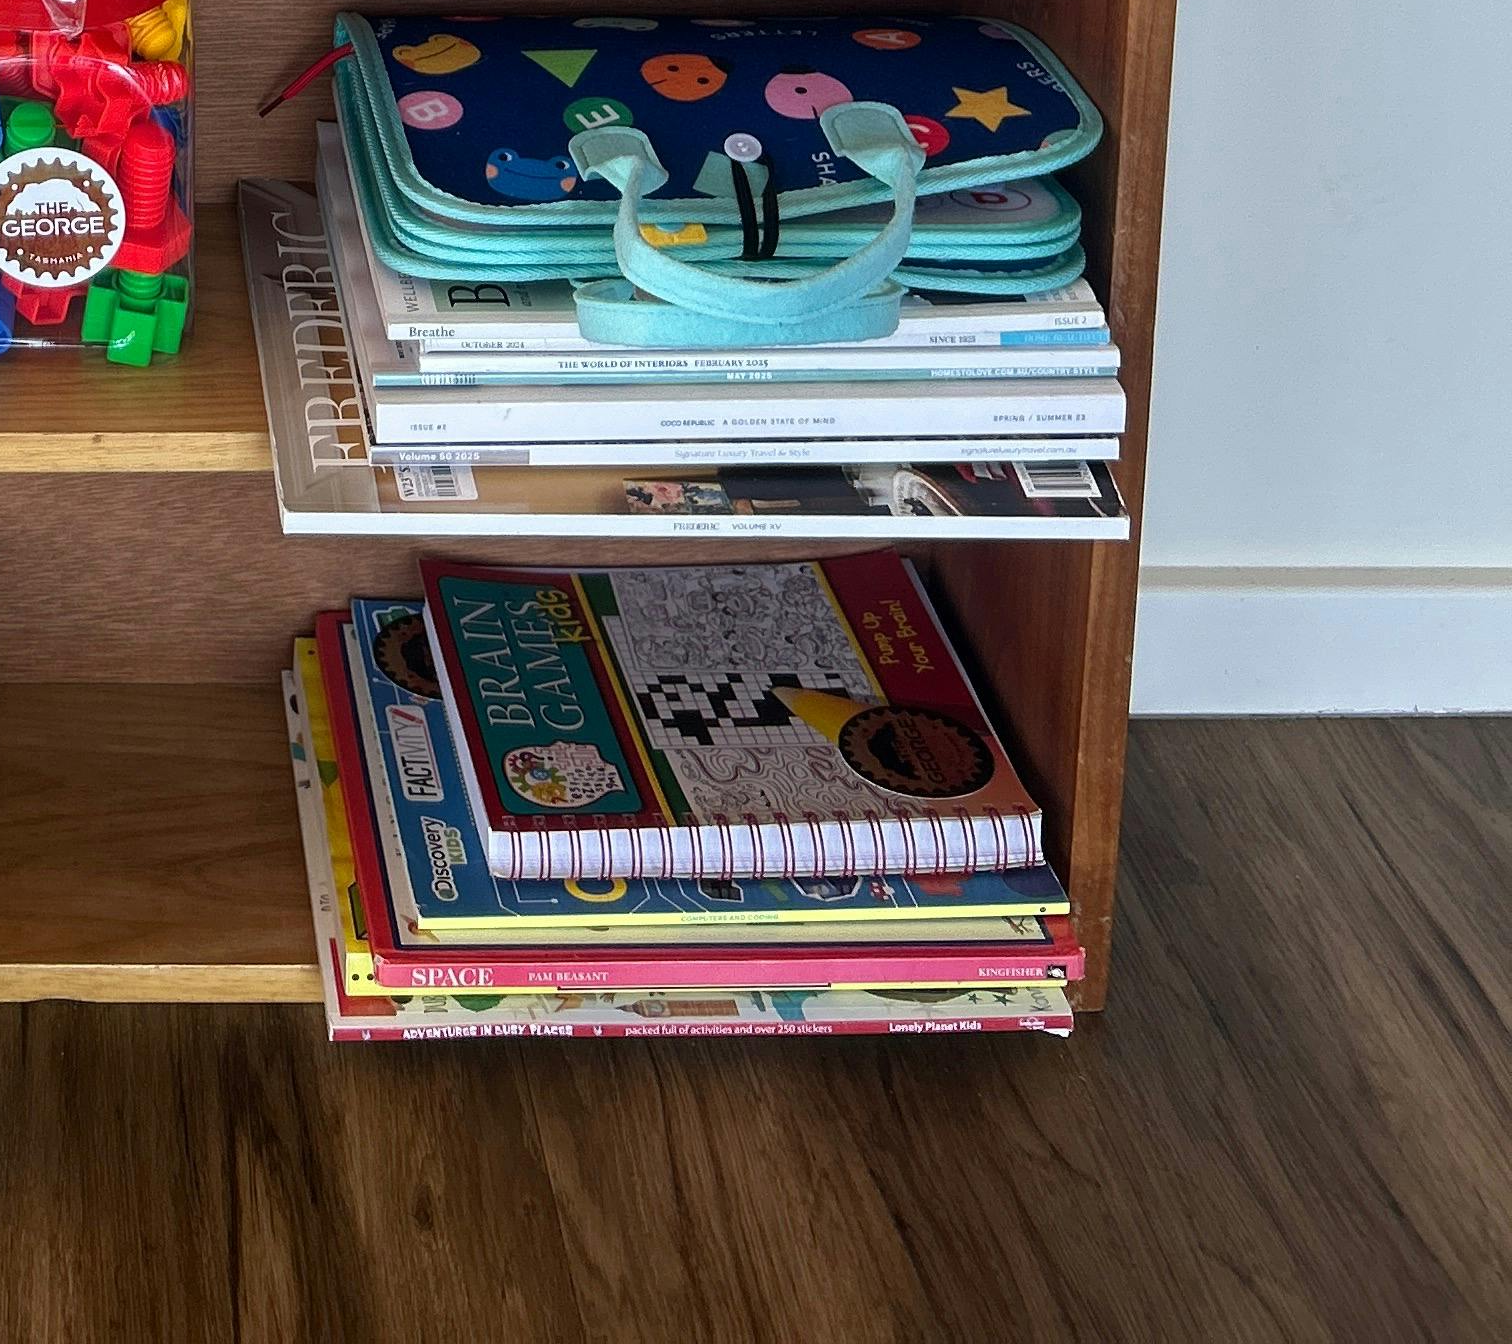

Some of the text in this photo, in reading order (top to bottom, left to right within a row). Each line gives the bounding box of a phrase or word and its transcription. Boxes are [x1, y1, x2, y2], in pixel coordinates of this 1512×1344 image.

[35, 201, 68, 214] THE
[1, 216, 105, 237] GEORGE
[270, 211, 370, 473] FREDERIC
[408, 326, 456, 338] Breathe
[453, 596, 536, 728] BRAIN
[504, 599, 585, 731] GAMES
[411, 967, 1044, 986] SPACE PAM BEASANT KINGFISHER
[889, 1021, 982, 1034] Lonely Planet Kids
